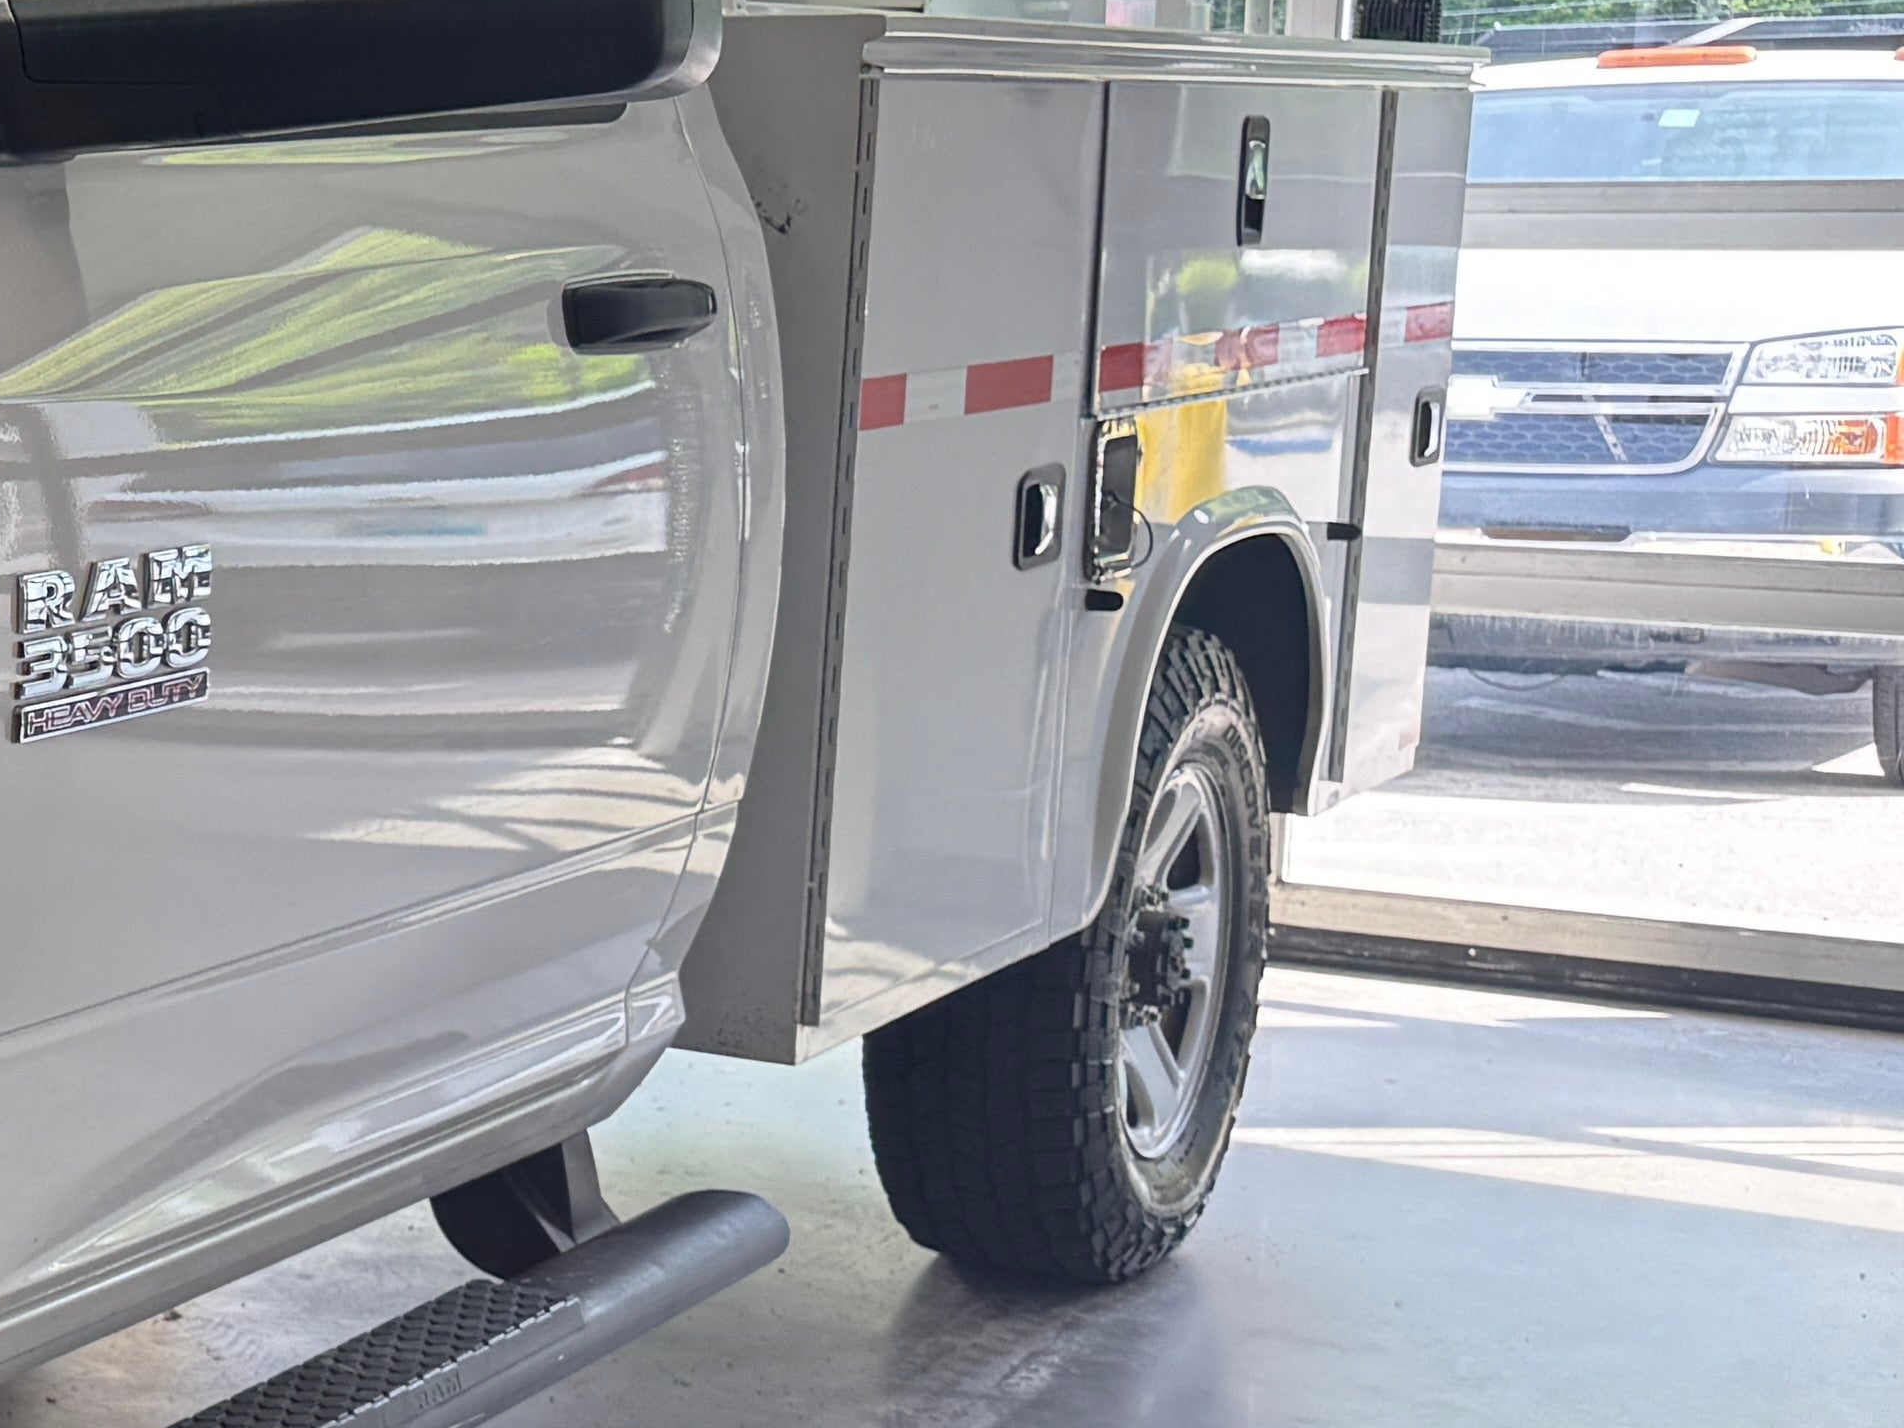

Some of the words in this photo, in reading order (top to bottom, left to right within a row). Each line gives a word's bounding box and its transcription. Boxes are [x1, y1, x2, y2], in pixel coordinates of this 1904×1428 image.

[17, 544, 211, 634] RAM
[17, 606, 211, 700] 3500
[25, 693, 124, 736] HEAVY
[127, 674, 203, 714] DUTY
